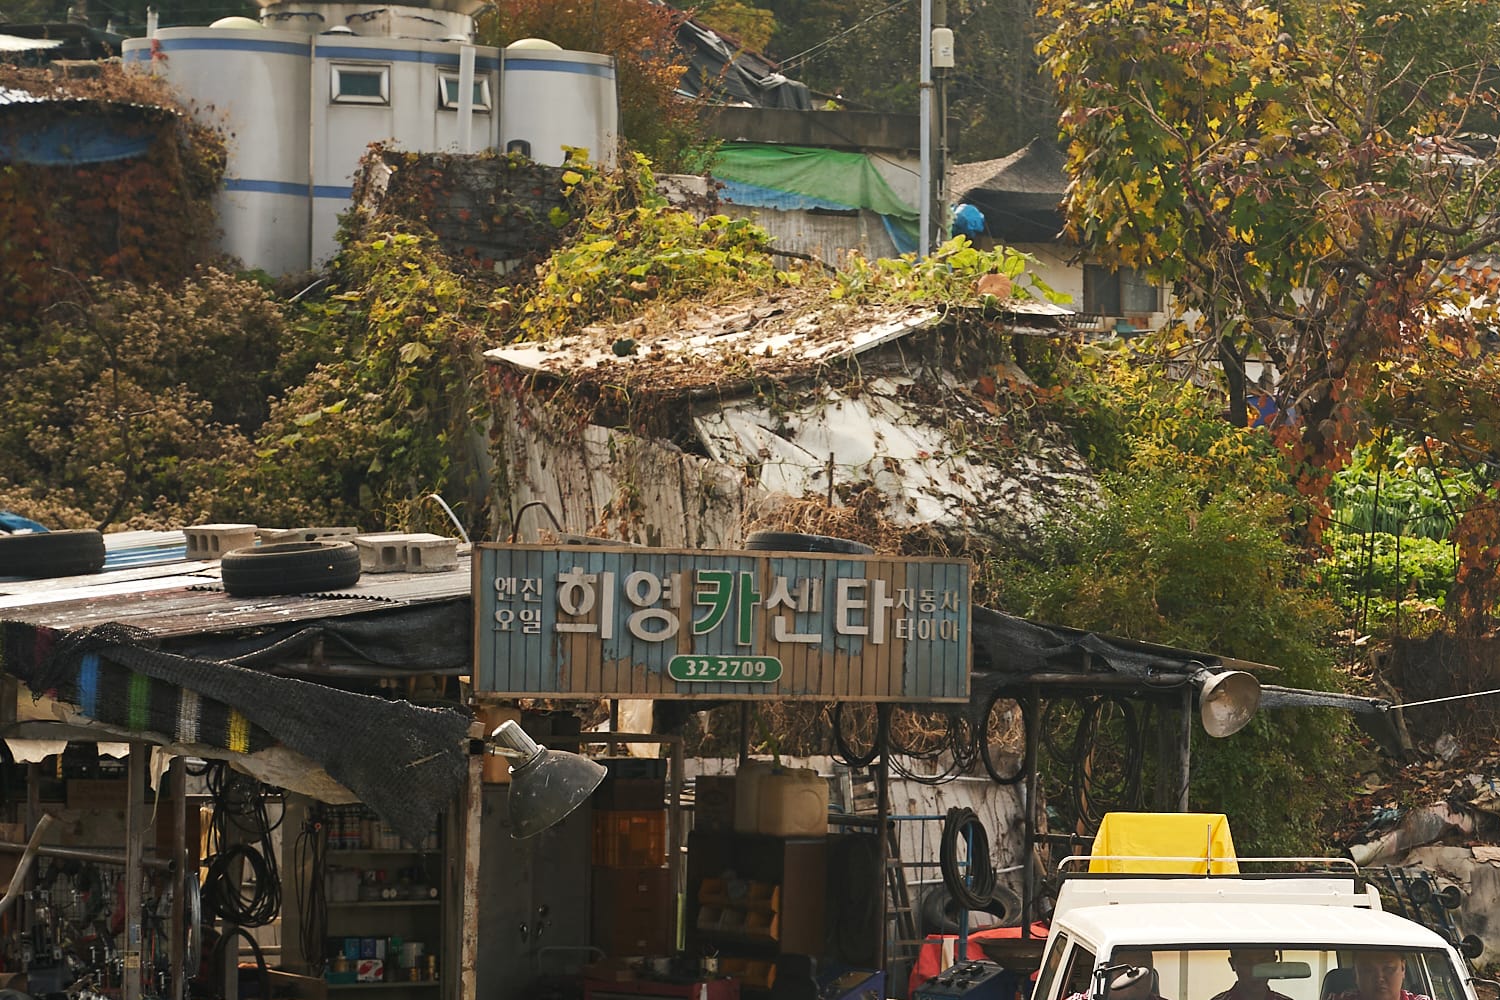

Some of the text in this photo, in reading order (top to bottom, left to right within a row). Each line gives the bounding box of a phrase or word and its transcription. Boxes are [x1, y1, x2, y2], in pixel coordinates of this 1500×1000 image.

[493, 576, 543, 602] 엔진
[555, 566, 894, 646] 희영카센타
[493, 609, 543, 635] 오일
[685, 660, 767, 678] 32-2709
